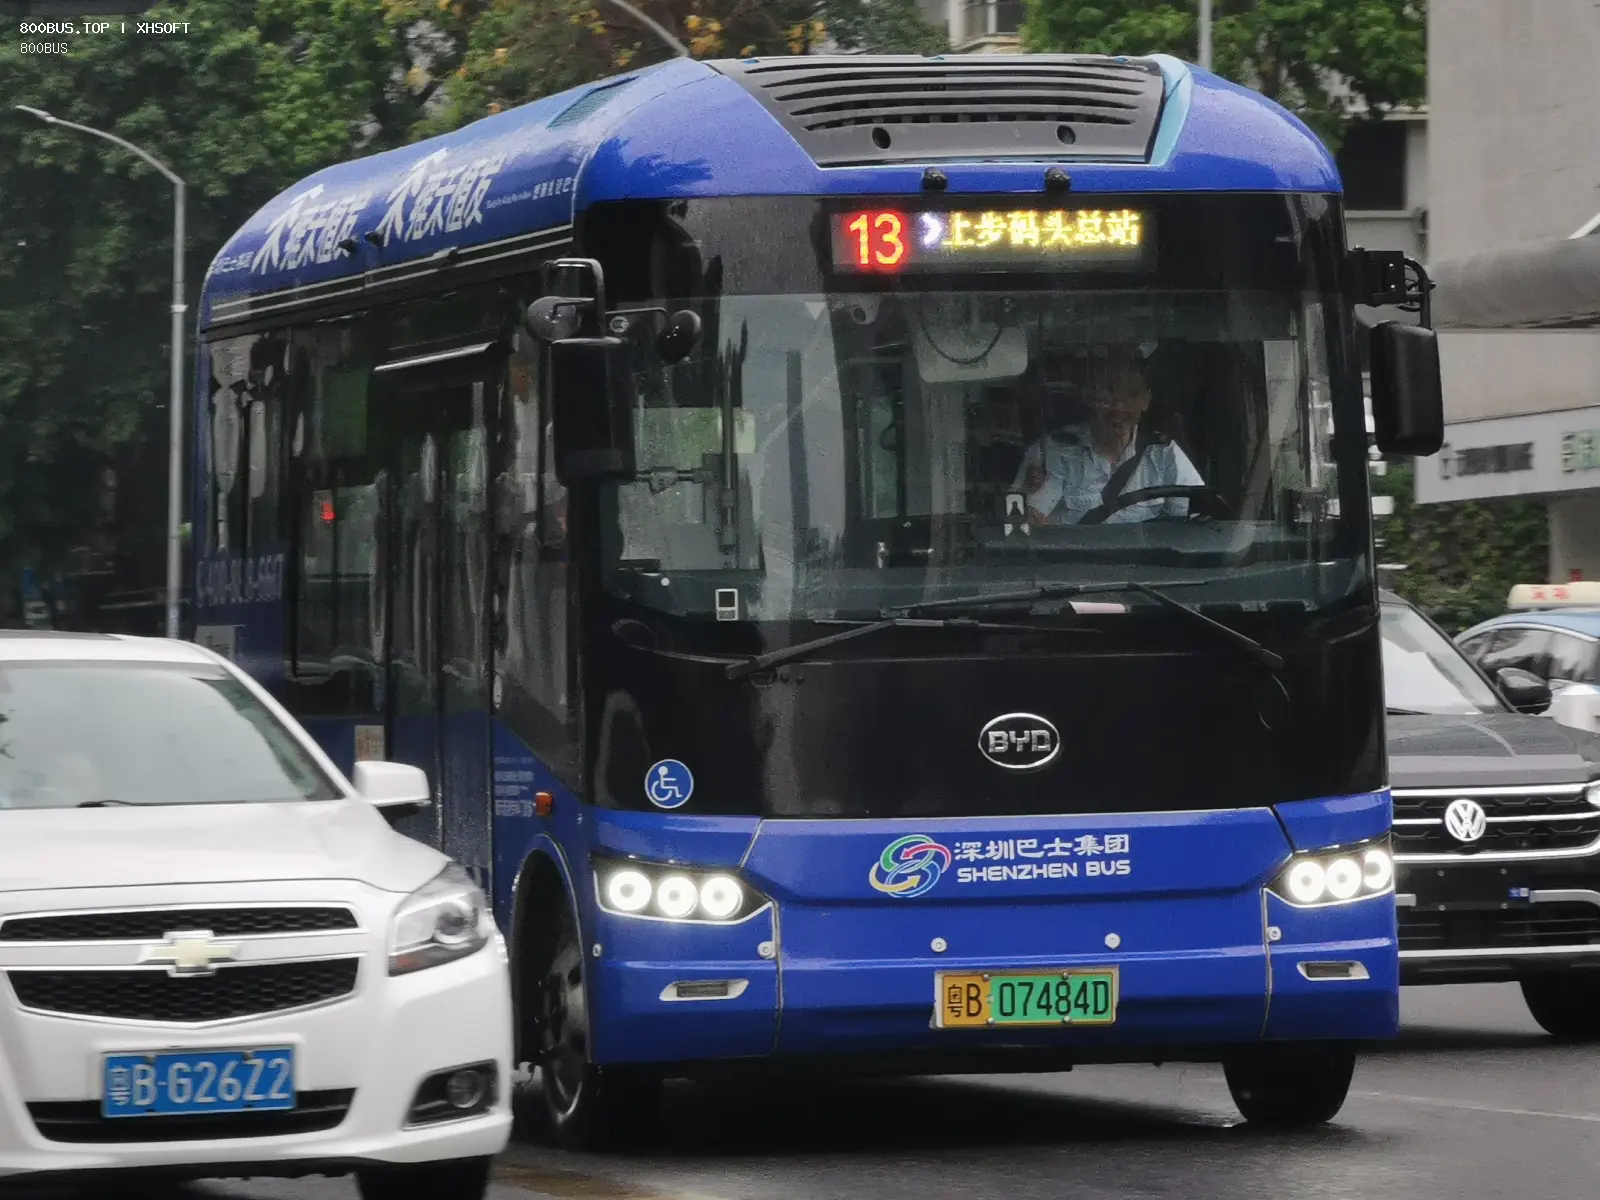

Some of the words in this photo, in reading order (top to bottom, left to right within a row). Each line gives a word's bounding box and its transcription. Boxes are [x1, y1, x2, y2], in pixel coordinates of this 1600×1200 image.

[849, 211, 905, 266] 13
[942, 208, 1141, 249] 上步码头总站
[988, 729, 1052, 753] BYD
[953, 833, 1130, 862] 深圳巴士集团
[956, 861, 1078, 883] SHENZHEN
[1085, 859, 1131, 877] BUS
